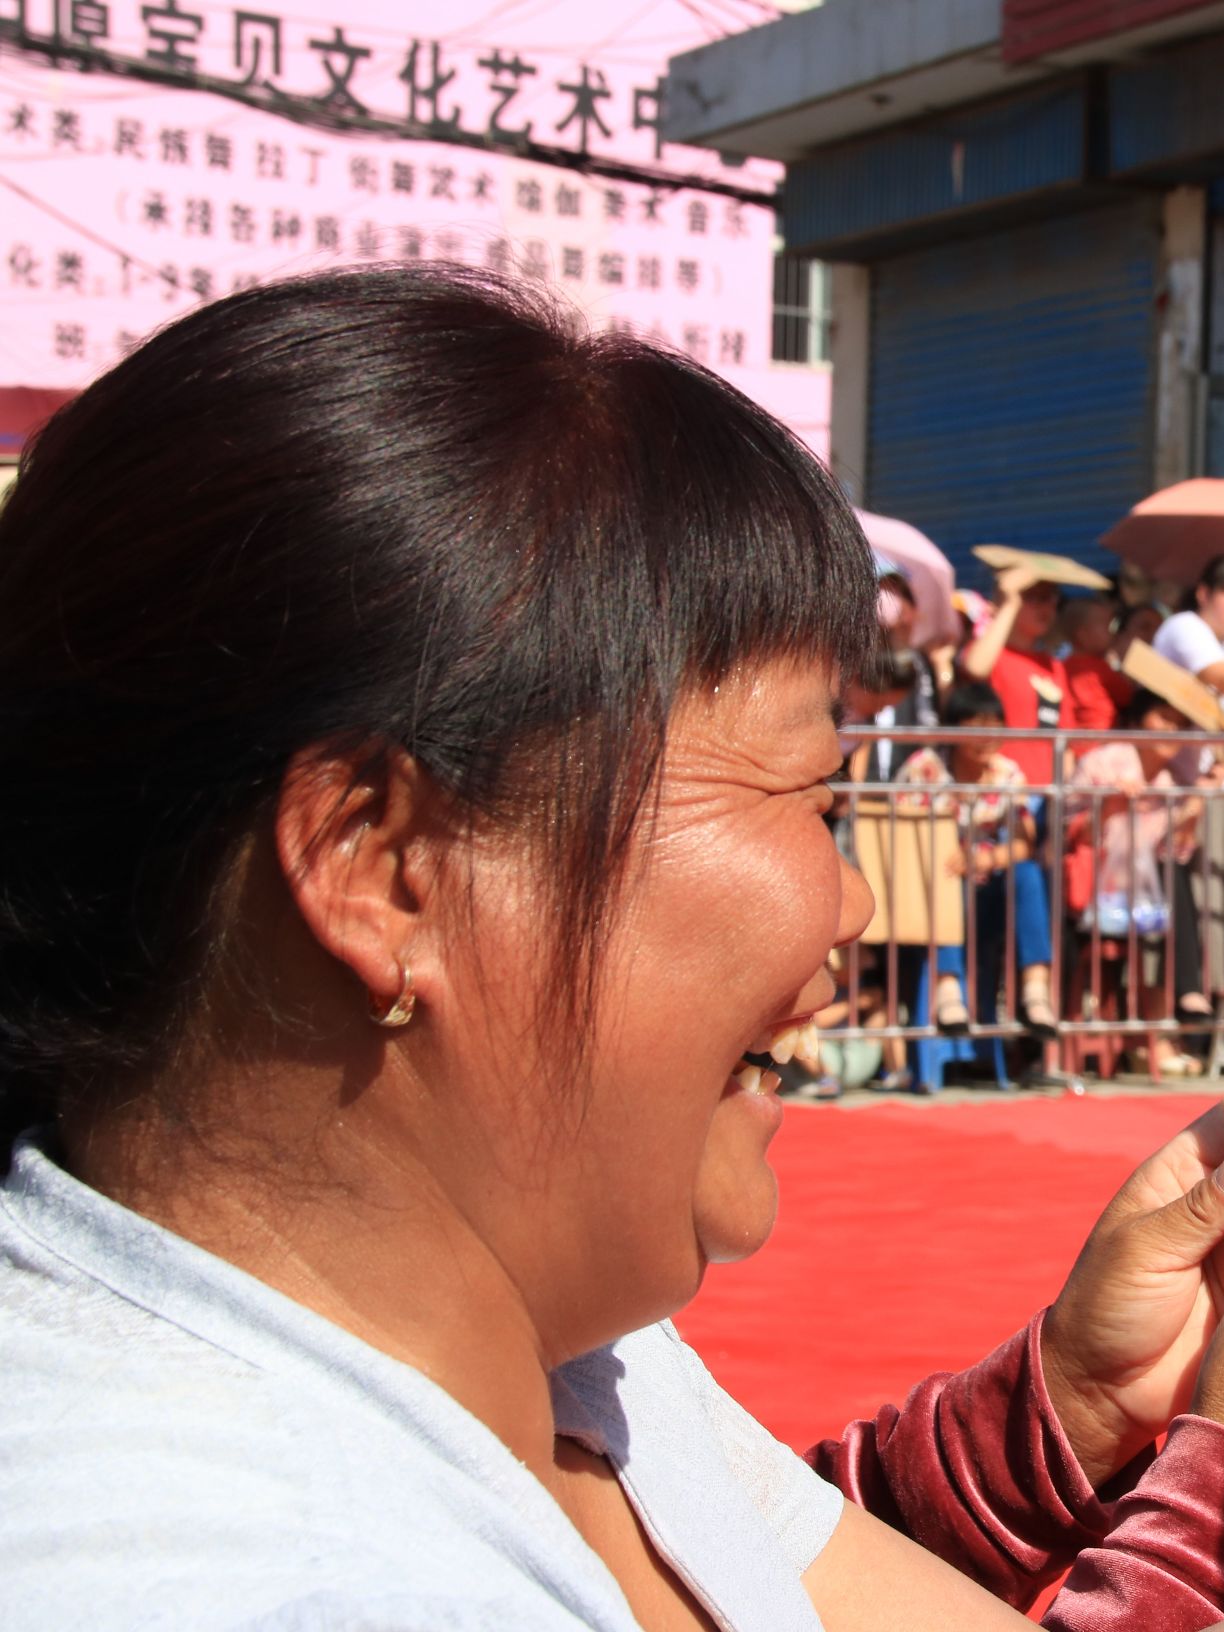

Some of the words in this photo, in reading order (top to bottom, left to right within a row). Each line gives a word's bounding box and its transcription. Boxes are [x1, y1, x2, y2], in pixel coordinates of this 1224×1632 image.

[0, 0, 663, 160] 原宝贝文化艺术中
